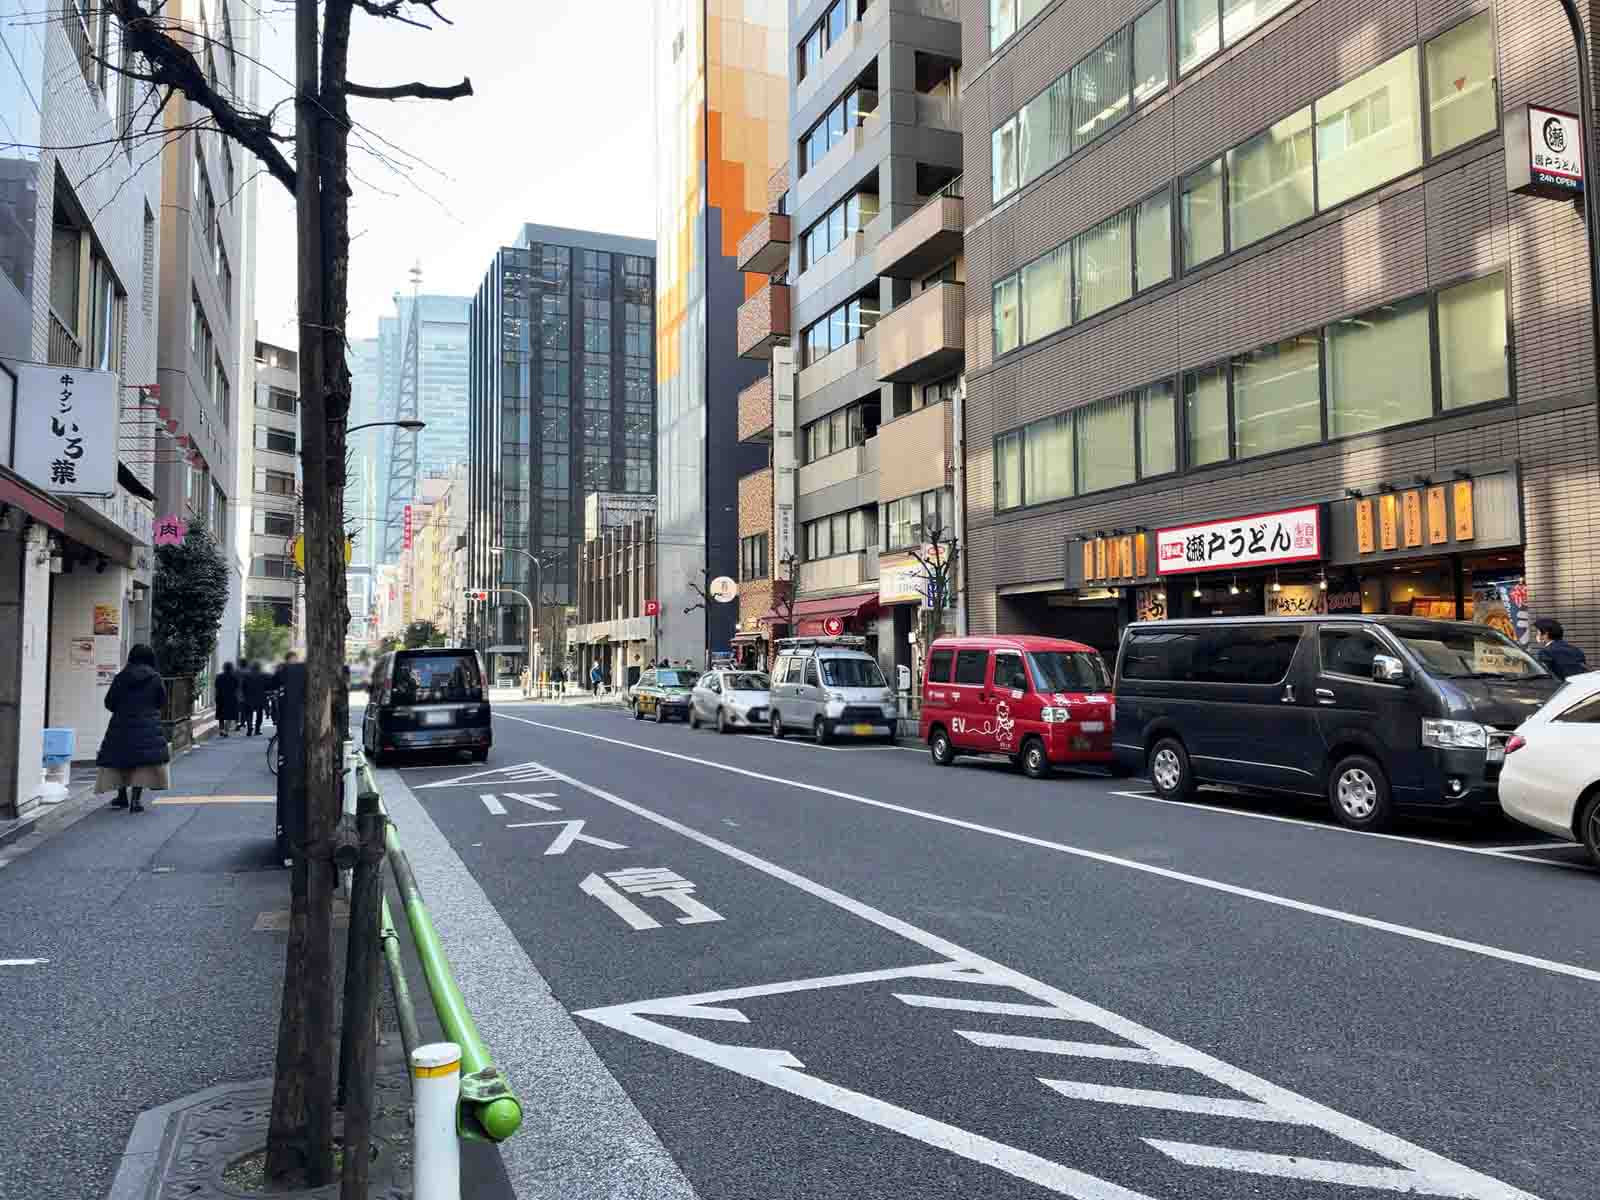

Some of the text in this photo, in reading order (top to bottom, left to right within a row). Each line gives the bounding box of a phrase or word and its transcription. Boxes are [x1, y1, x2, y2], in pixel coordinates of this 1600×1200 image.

[1540, 173, 1577, 187] 24h OPEN
[59, 374, 75, 413] 牛タン
[50, 416, 84, 484] いろ葉
[160, 523, 178, 537] 肉
[1186, 522, 1291, 562] 瀬戸うどん
[648, 603, 656, 614] P
[952, 717, 965, 733] EV
